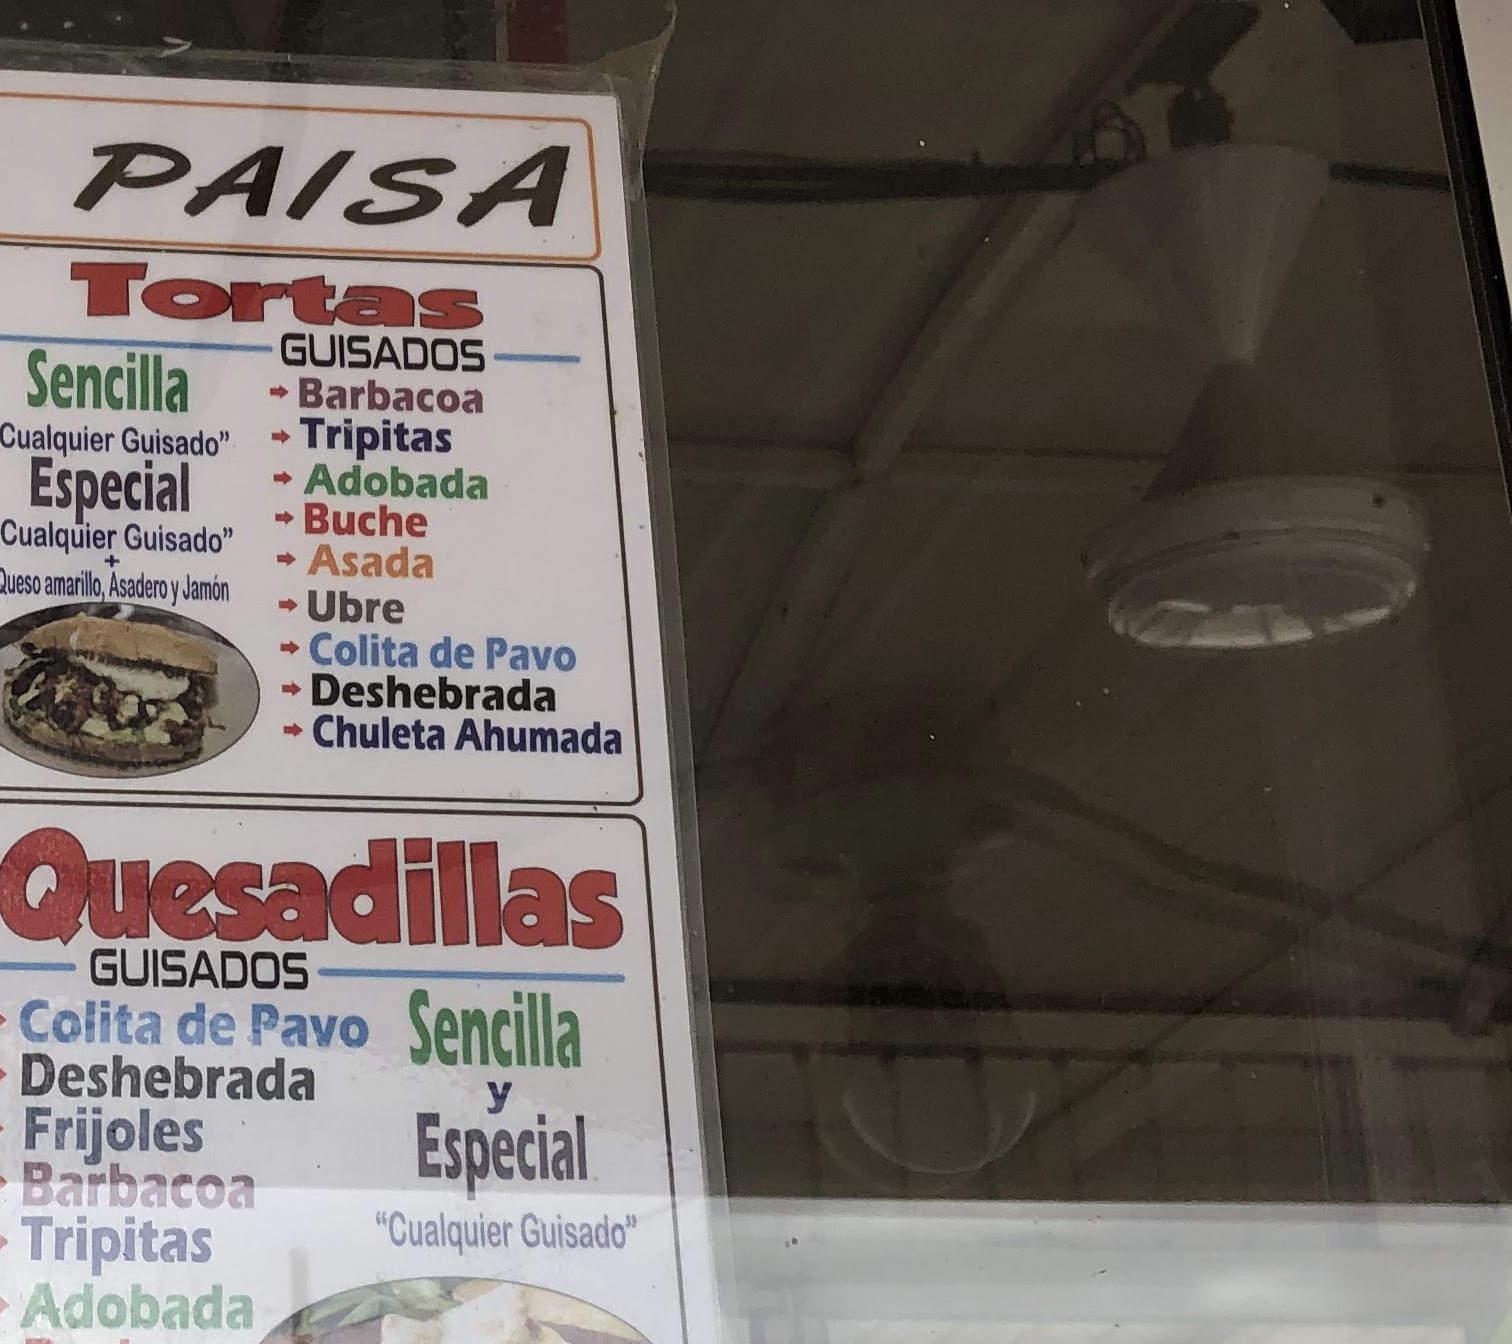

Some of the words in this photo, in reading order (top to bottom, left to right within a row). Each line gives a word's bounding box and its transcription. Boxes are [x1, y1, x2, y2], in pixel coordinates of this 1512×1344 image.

[74, 141, 572, 229] PAISA
[70, 261, 484, 330] Tortas
[280, 332, 486, 372] GUISADOS
[26, 348, 189, 414] Sencilla
[297, 377, 484, 415] Barbacoa
[299, 417, 452, 463] Tripitas
[30, 456, 190, 524] Especial
[304, 462, 489, 500] Adobada
[304, 505, 428, 538] Buche
[307, 544, 435, 580] Asada
[44, 569, 106, 603] amarillo,
[108, 572, 167, 601] Asadero
[169, 578, 179, 607] y
[181, 571, 230, 603] Jamón
[307, 589, 405, 624] Ubre
[308, 632, 418, 669] Colita
[430, 635, 482, 671] de
[486, 637, 577, 672] Pavo
[311, 673, 557, 714] Deshebrada
[313, 714, 450, 753] Chuleta
[455, 716, 622, 756] Ahumada
[89, 948, 309, 990] GUISADOS
[20, 999, 161, 1046] Colita
[177, 1004, 237, 1047] de
[252, 1005, 370, 1049] Pavo
[408, 989, 582, 1069] Sencilla
[22, 1053, 316, 1102] Deshebrada
[487, 1081, 512, 1113] y
[23, 1108, 205, 1164] Frijoles
[416, 1112, 587, 1199] Especial
[22, 1162, 256, 1210] Barbacoa
[20, 1216, 212, 1274] Tripitas
[21, 1283, 254, 1331] Adobada
